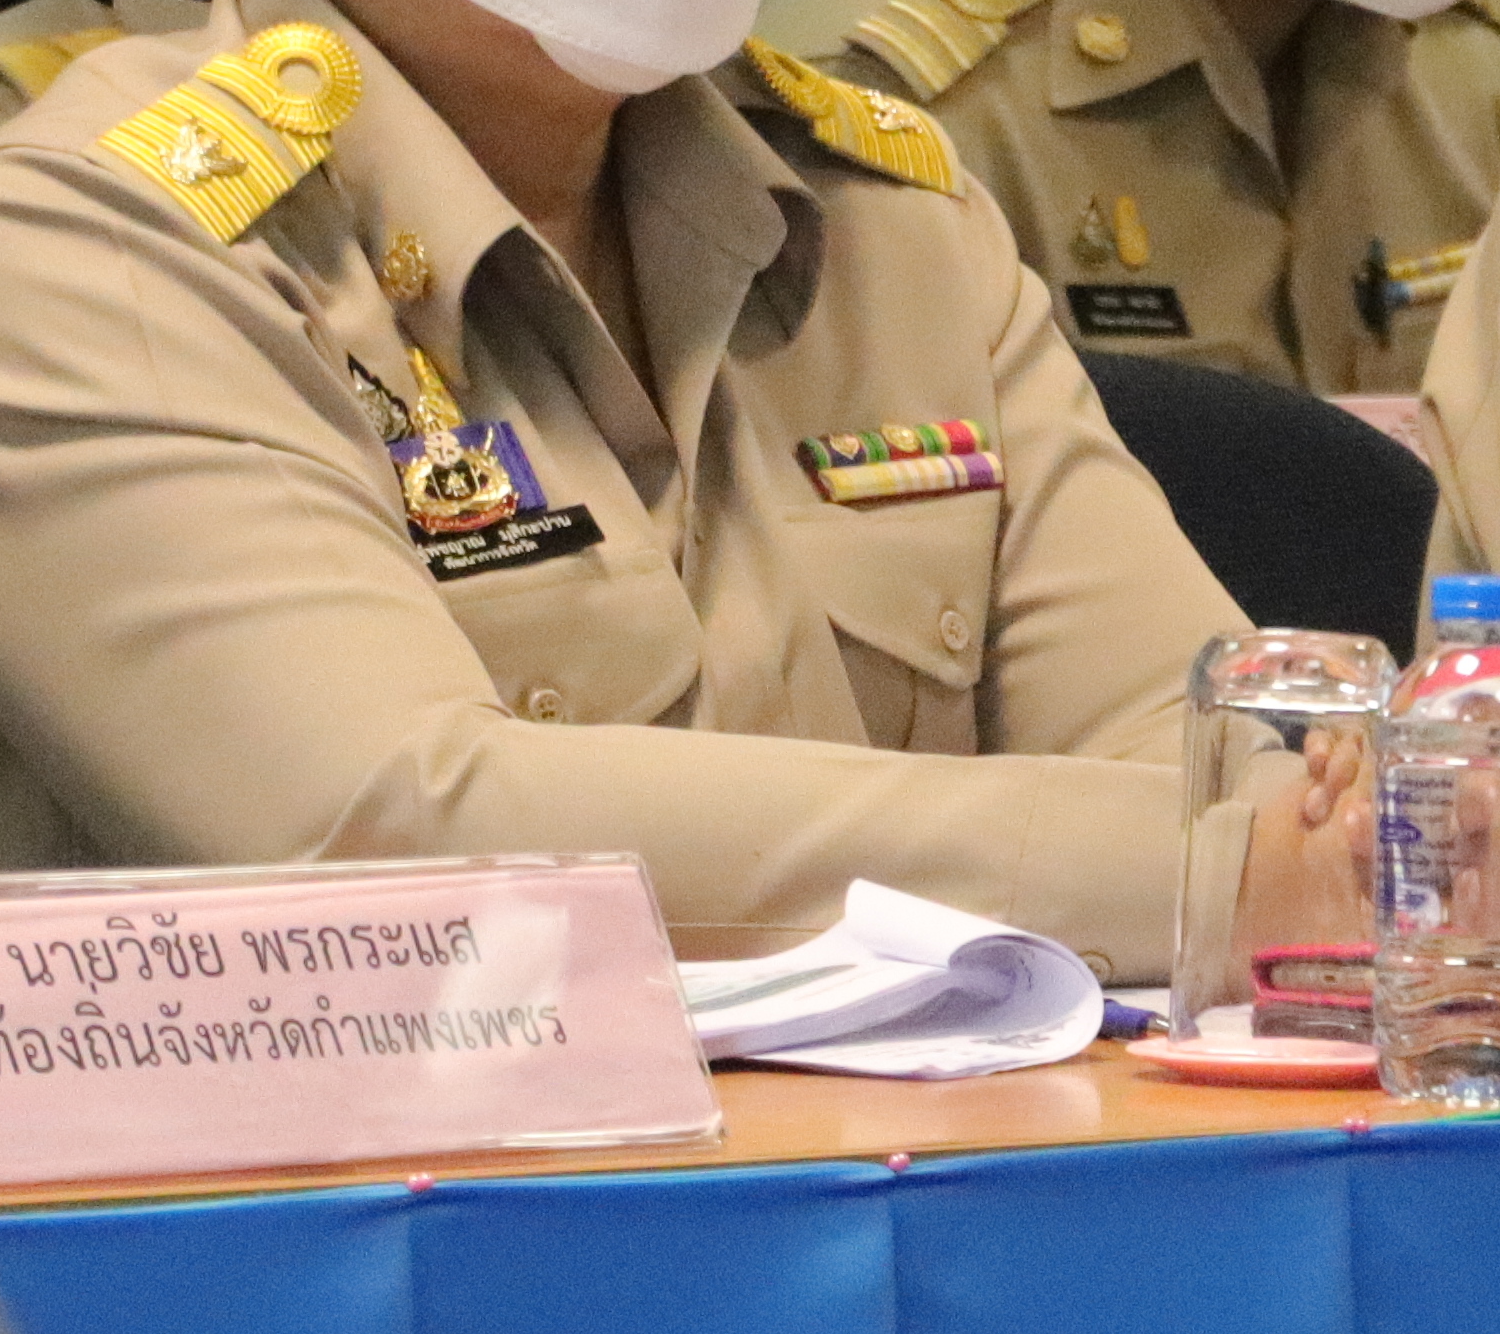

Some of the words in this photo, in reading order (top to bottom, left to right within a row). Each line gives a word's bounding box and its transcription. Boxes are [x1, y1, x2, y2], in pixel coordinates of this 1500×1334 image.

[6, 911, 226, 987] นายวิชัย
[240, 916, 482, 975] พรกระแส
